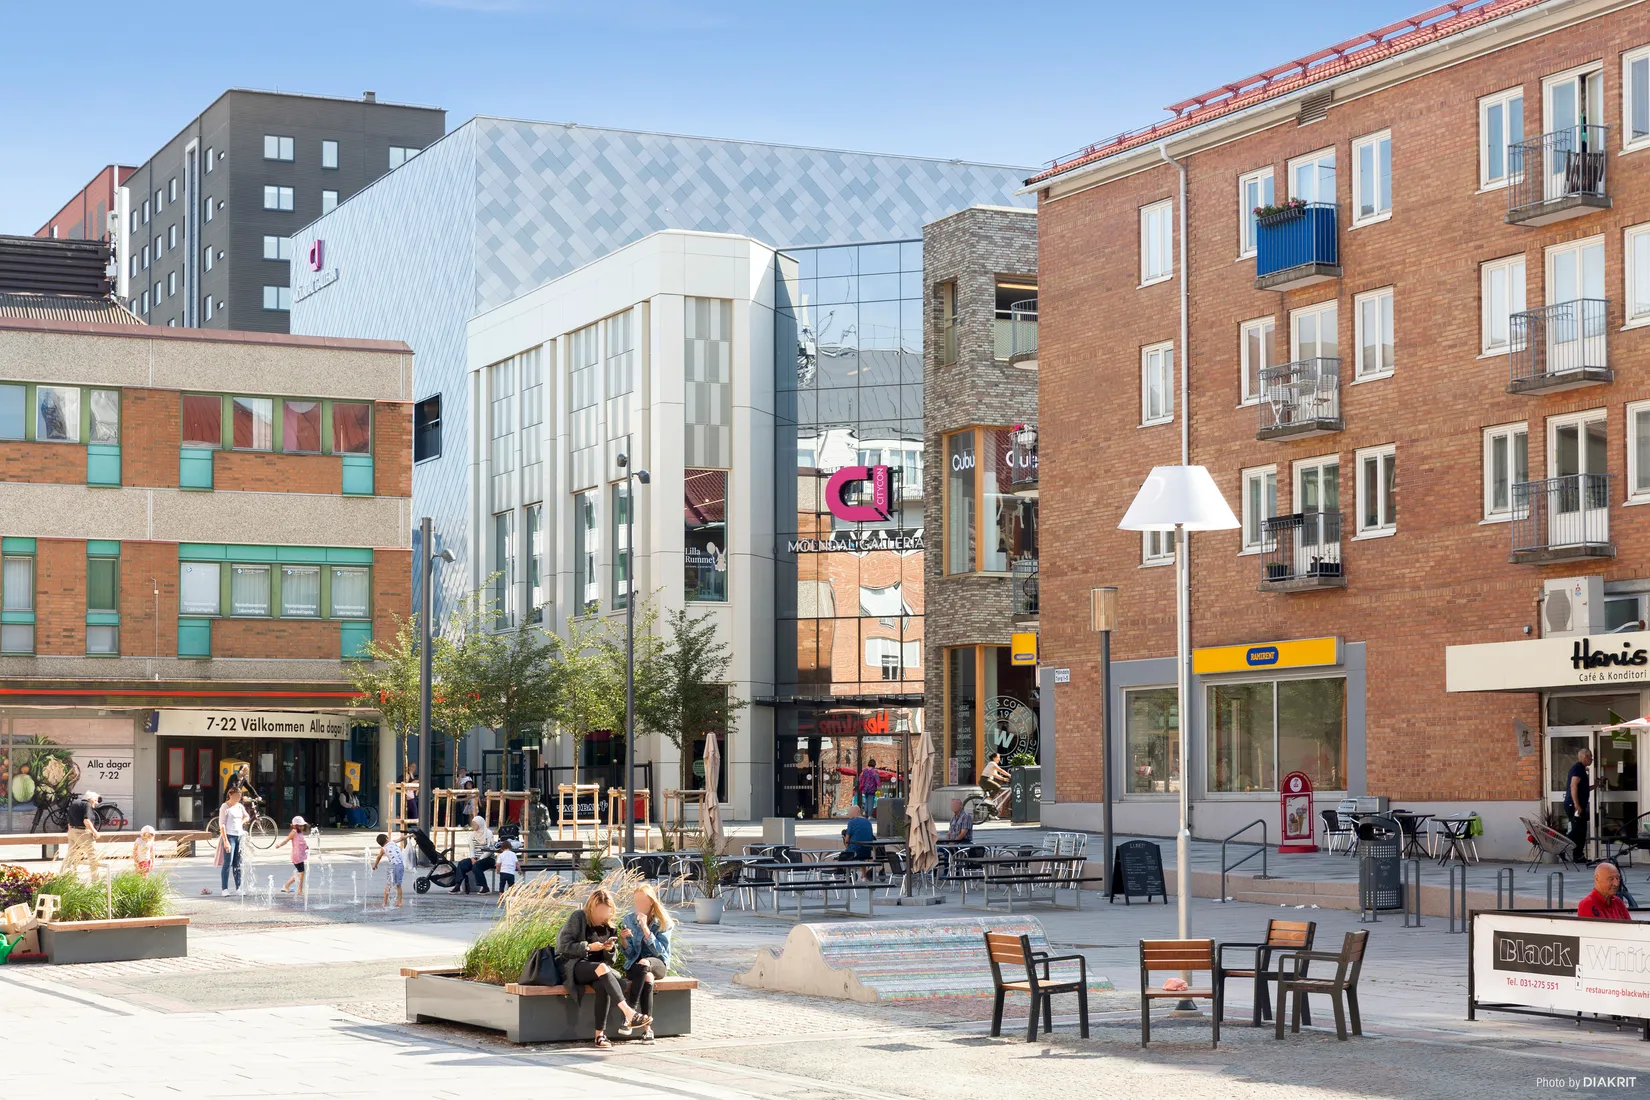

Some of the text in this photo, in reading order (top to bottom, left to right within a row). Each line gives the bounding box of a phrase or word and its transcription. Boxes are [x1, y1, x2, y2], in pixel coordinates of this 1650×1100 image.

[876, 467, 885, 506] CITYCON
[685, 546, 701, 556] Lilla
[787, 536, 925, 553] MÖLNDAL GALLERIA
[685, 555, 716, 564] Rummet
[1570, 638, 1648, 670] Hanis
[1579, 669, 1647, 682] Café & Konditori
[206, 716, 237, 731] 7-22
[241, 716, 305, 733] Välkommen
[309, 719, 325, 733] Alla
[326, 719, 342, 738] dagar
[993, 727, 1015, 749] W
[87, 759, 132, 771] Alla dagar
[99, 771, 120, 780] 7-22
[1500, 937, 1573, 968] Black
[1506, 977, 1560, 991] Tel. 031-275 551
